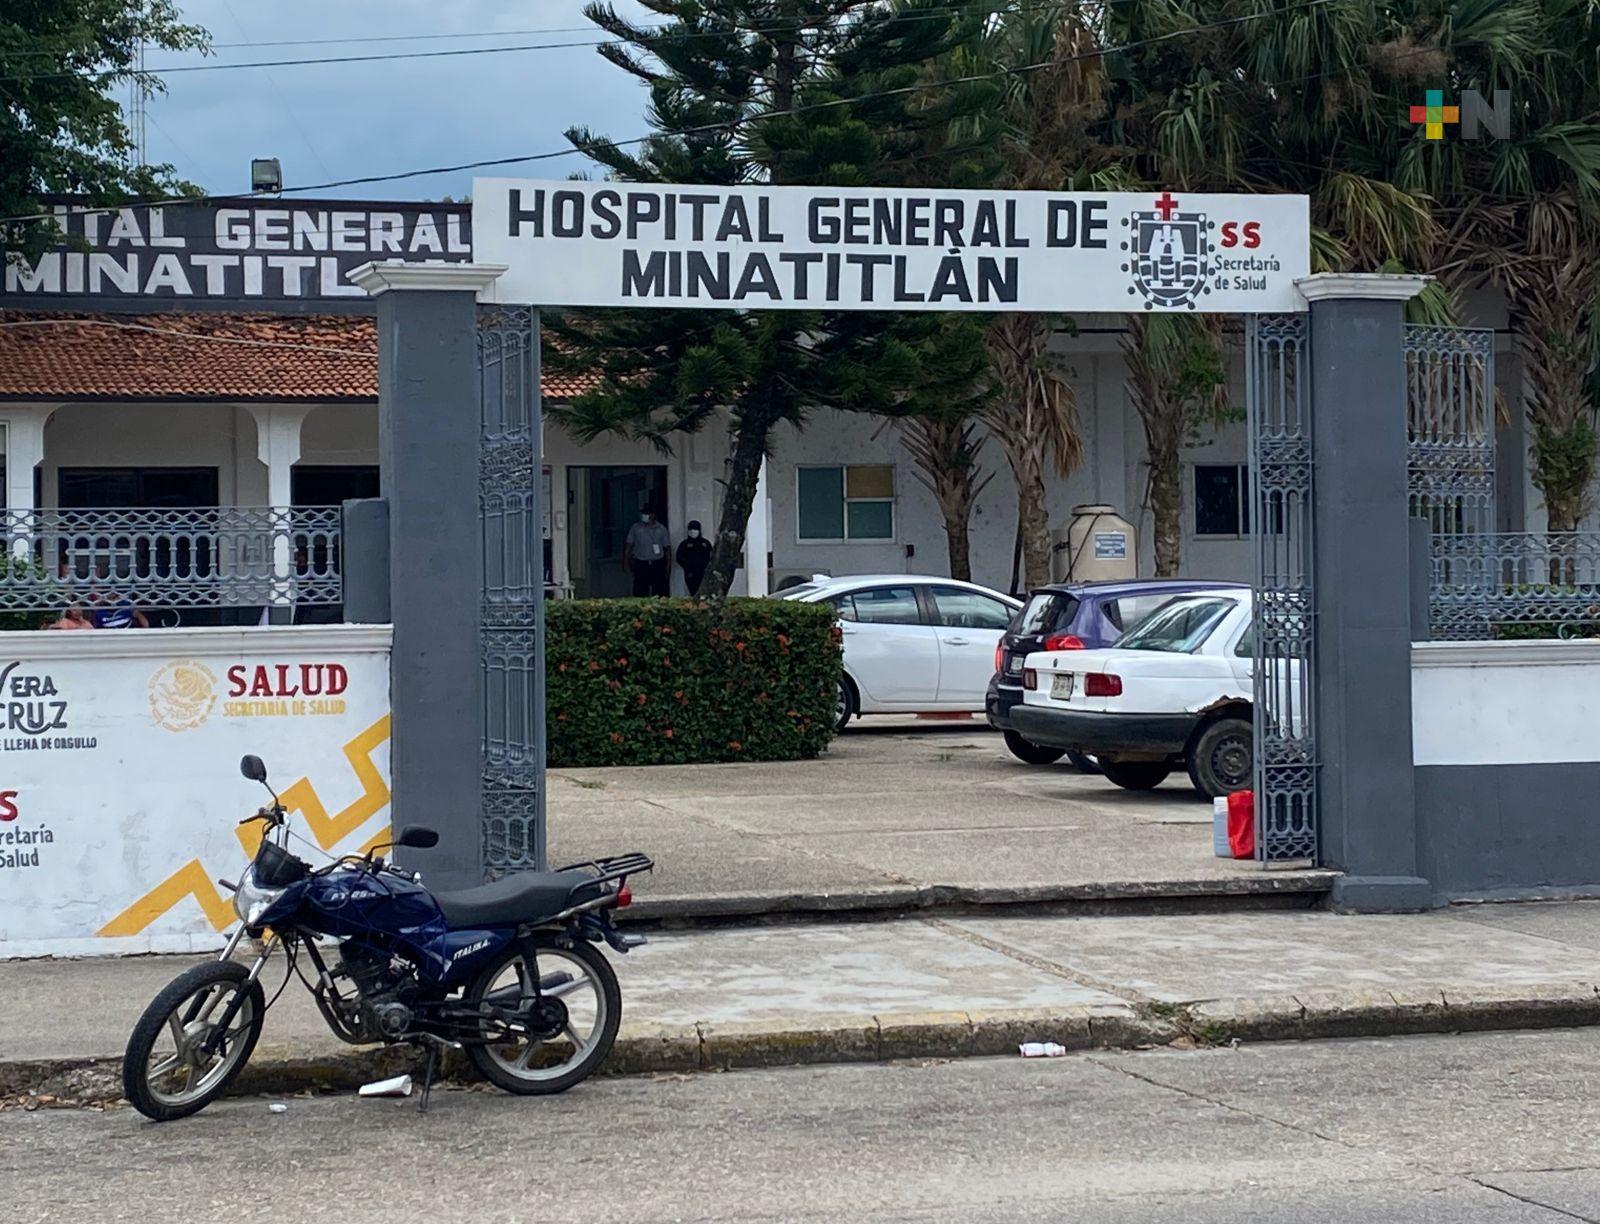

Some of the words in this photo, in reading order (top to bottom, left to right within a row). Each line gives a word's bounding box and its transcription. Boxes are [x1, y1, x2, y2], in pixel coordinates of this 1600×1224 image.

[215, 208, 471, 253] GENERAL
[508, 189, 784, 243] HOSPITAL
[808, 197, 1030, 248] GENERAL
[1046, 199, 1108, 249] DE
[1221, 221, 1261, 249] SS
[5, 250, 467, 296] MINATITL
[621, 247, 1019, 303] MINATITLÁN
[1214, 254, 1281, 272] Secretaría
[1214, 275, 1229, 290] de
[1233, 275, 1267, 291] Salud
[227, 663, 348, 698] SALUD
[0, 701, 68, 735] RUZ
[292, 700, 307, 715] DE
[308, 699, 346, 716] SALUD
[41, 738, 52, 749] DE
[54, 737, 97, 749] ORGULLO
